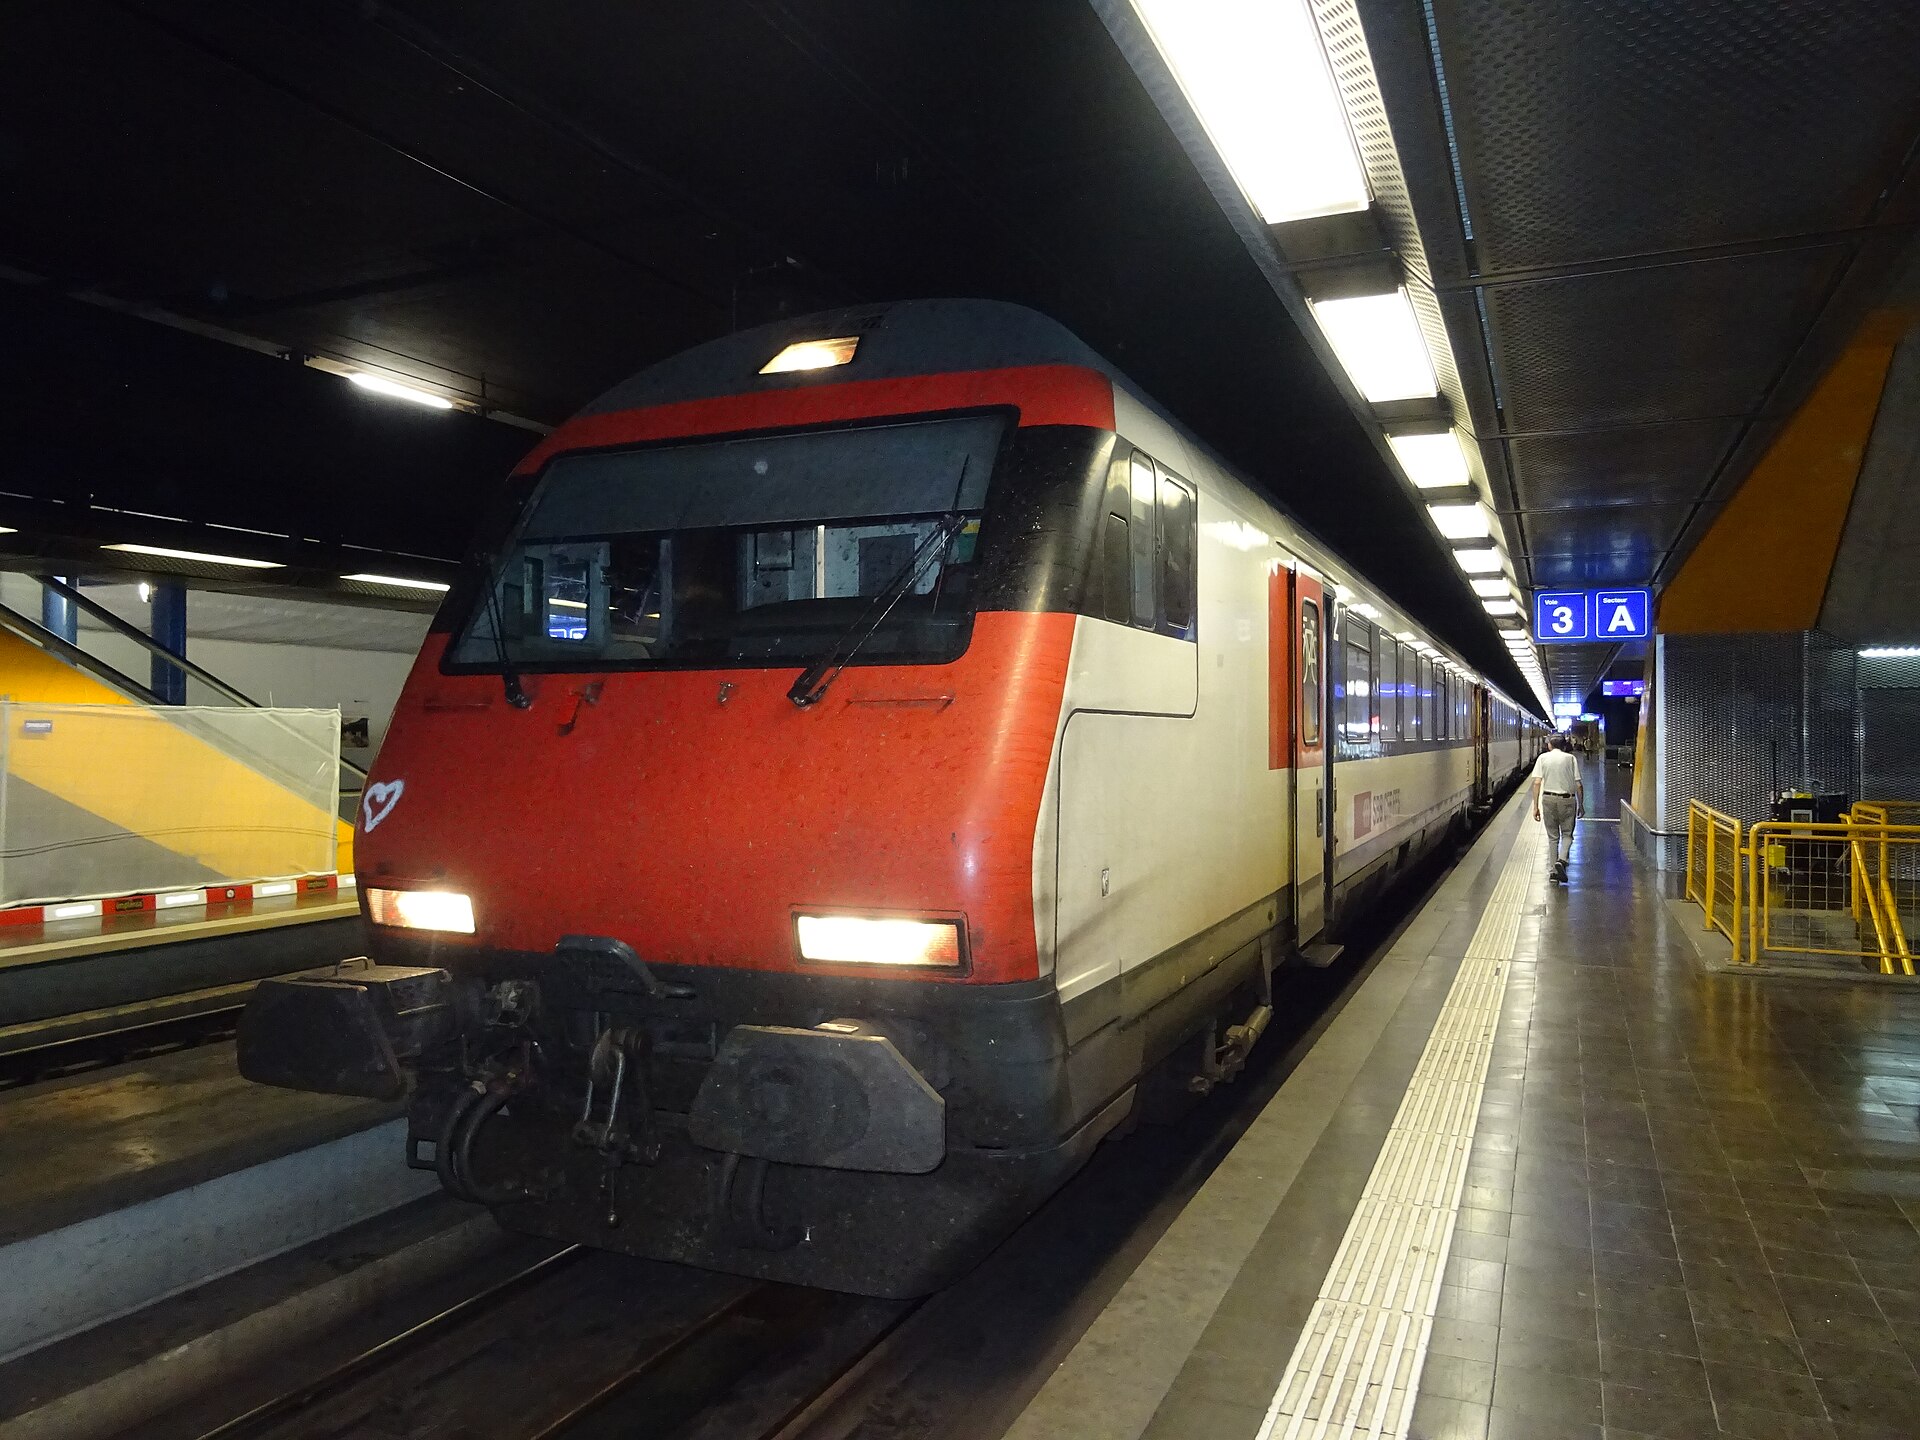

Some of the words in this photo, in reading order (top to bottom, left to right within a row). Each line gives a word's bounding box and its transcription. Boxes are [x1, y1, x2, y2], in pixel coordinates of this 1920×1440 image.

[1333, 600, 1339, 641] 2
[1551, 606, 1574, 634] 3
[1607, 605, 1636, 632] A
